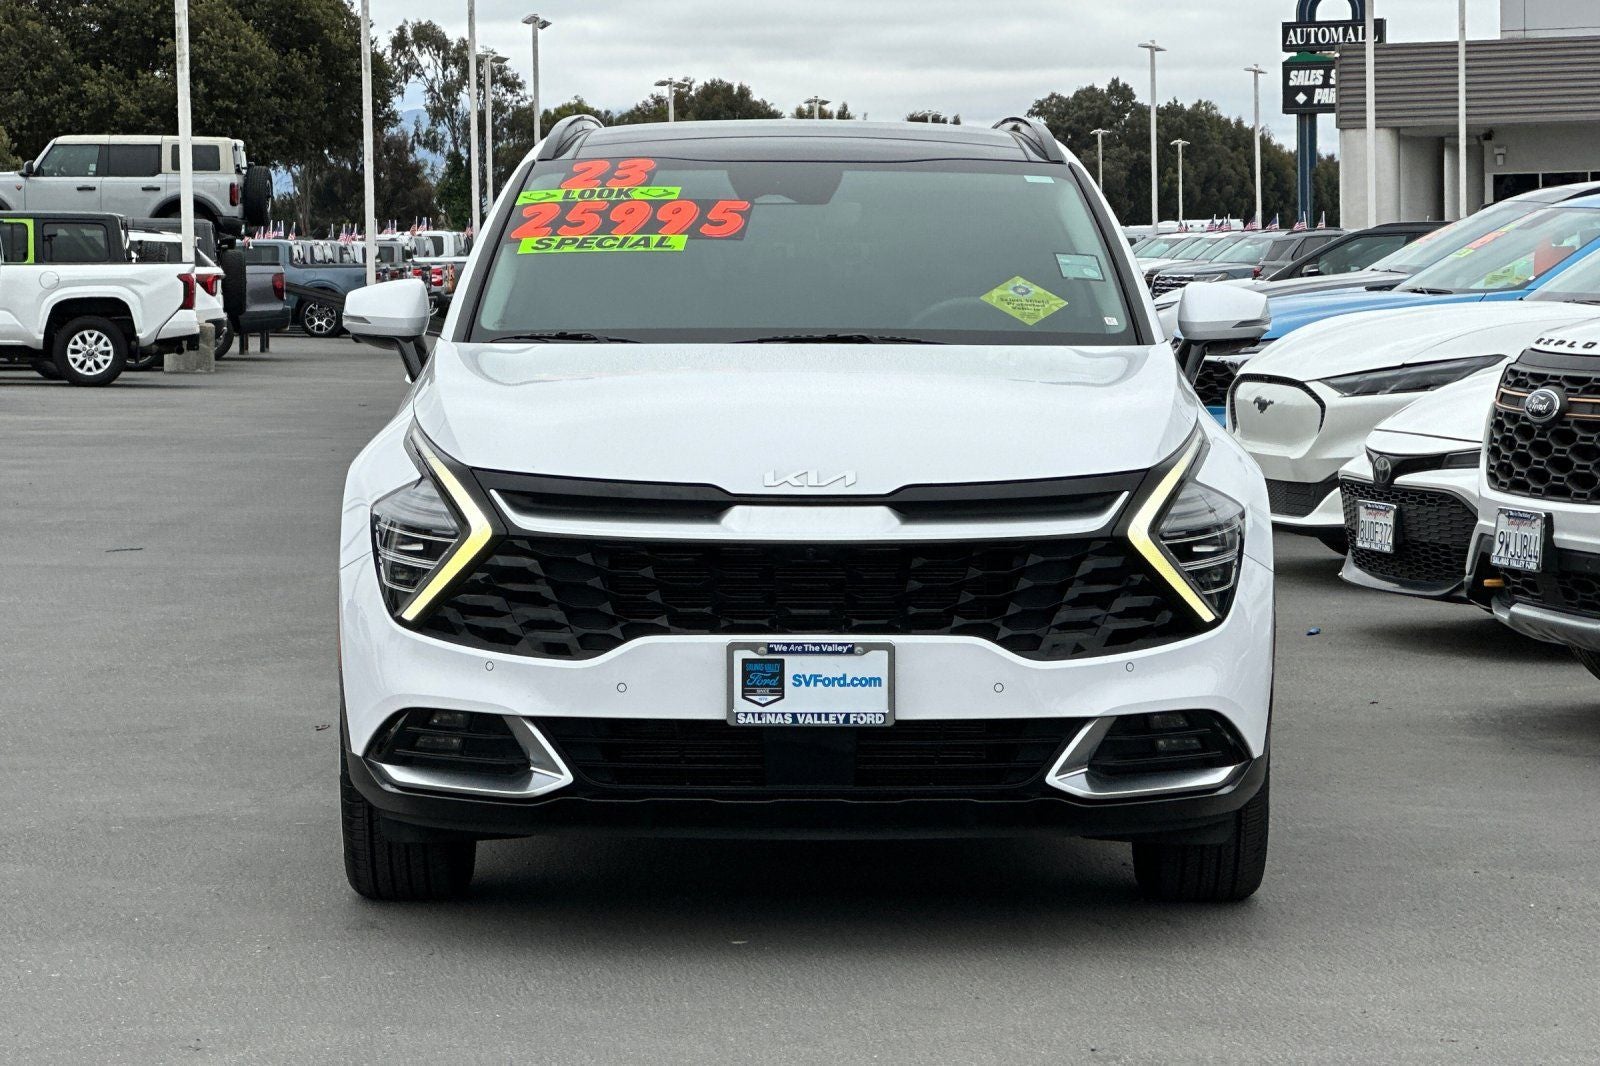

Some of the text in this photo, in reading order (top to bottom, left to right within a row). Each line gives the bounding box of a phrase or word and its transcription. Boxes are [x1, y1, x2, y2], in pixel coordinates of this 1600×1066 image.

[1286, 25, 1378, 45] AUTOMAL
[1288, 69, 1324, 86] SALES
[560, 159, 656, 189] 23
[562, 187, 635, 200] LOOK
[510, 200, 750, 238] 25995
[530, 235, 675, 251] SPECIAL
[788, 643, 803, 652] Are
[803, 643, 820, 652] The
[746, 672, 780, 686] Ford
[791, 673, 883, 688] SVFord.com
[737, 713, 885, 724] SALINAS VALLEY FORD
